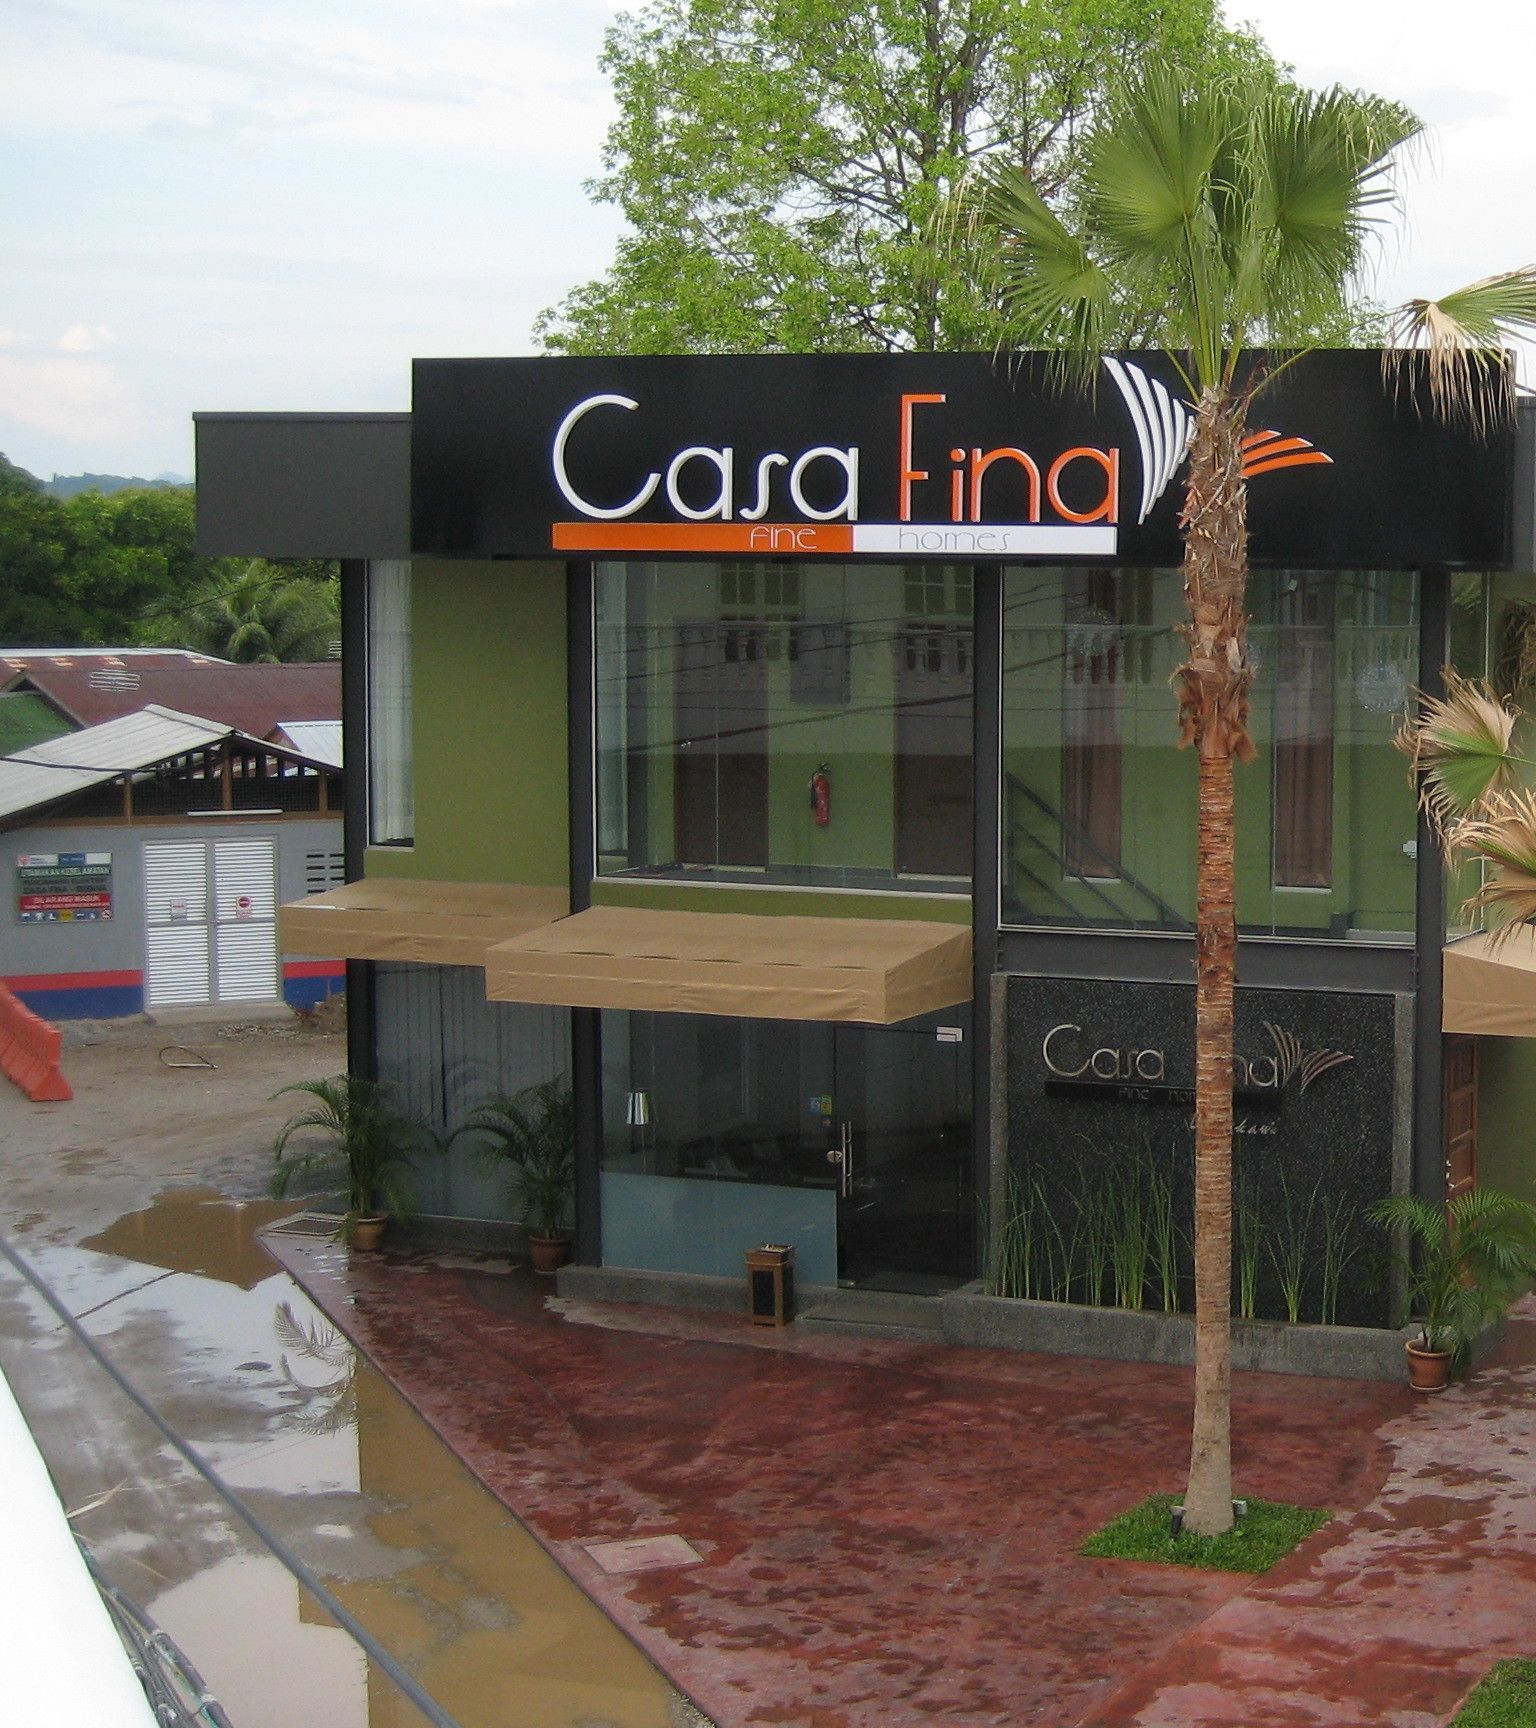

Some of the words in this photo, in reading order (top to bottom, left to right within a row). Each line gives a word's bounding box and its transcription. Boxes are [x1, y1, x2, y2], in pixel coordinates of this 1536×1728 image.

[553, 393, 859, 521] Casa
[898, 393, 1121, 524] Fina
[749, 525, 817, 550] fine
[899, 526, 1011, 552] homes
[1043, 1023, 1164, 1081] Casa
